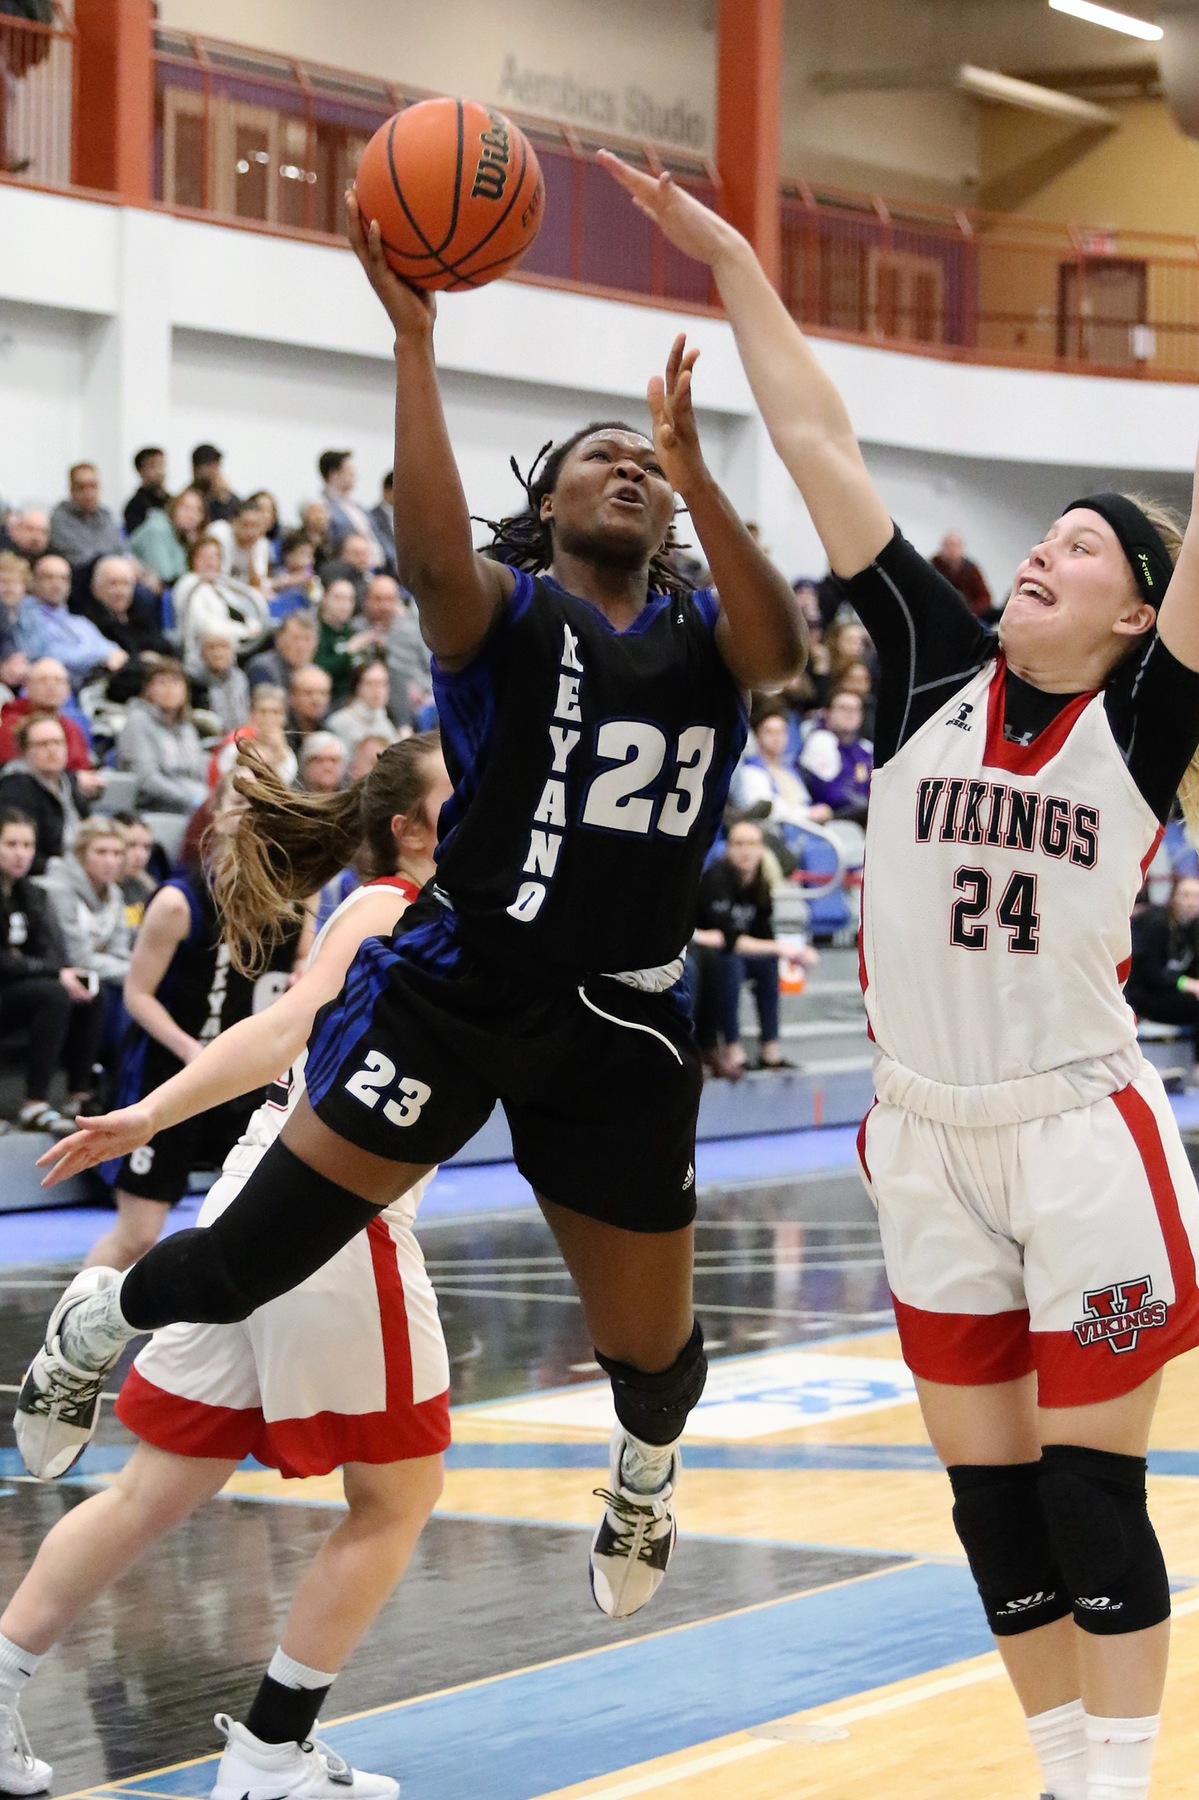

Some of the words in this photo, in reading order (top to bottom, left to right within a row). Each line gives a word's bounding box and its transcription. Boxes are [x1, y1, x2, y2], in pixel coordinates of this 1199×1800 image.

[505, 623, 584, 923] KEYANO
[581, 719, 717, 838] 23
[915, 777, 1100, 870] VIKINGS
[949, 864, 1041, 954] 24
[343, 1049, 433, 1128] 23
[129, 1144, 156, 1176] 6
[1073, 1299, 1168, 1346] VIKINGS
